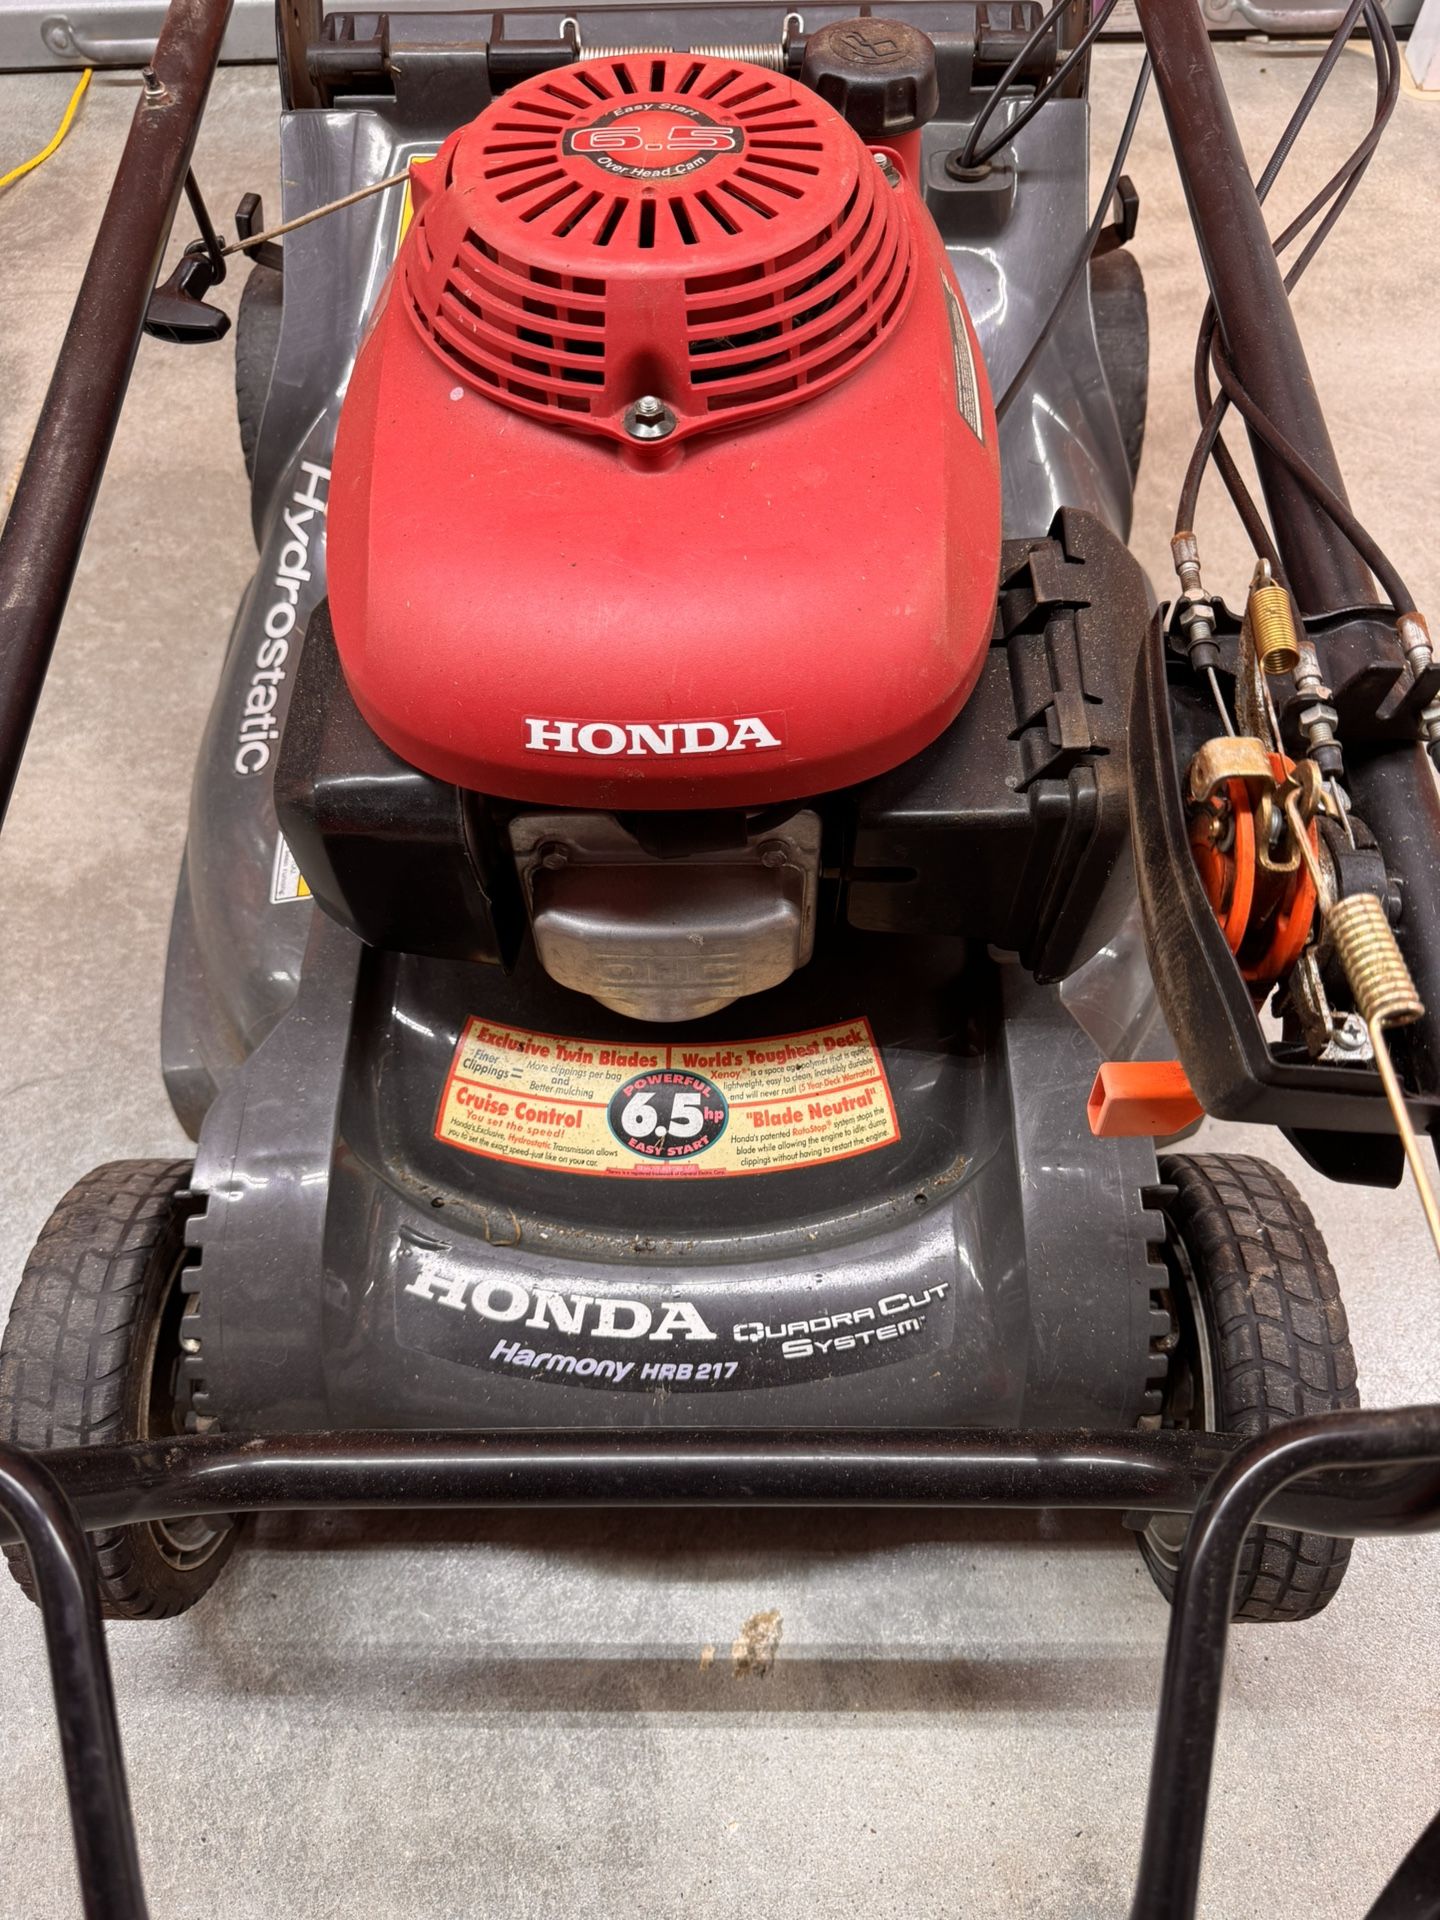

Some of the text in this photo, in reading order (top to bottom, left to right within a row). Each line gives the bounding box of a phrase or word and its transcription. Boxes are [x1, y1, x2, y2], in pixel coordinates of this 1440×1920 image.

[614, 102, 700, 117] Easy Start
[570, 126, 736, 152] 6.5
[597, 156, 707, 178] Over Head Cam
[234, 461, 331, 776] Hydrostatic
[525, 717, 782, 755] HONDA
[473, 1049, 500, 1064] Finer
[476, 1026, 658, 1068] Exclusive Twin Blades
[682, 1028, 864, 1068] World's Toughest Deck
[463, 1058, 509, 1080] Clippings
[526, 1060, 622, 1081] More clippings per bag
[551, 1076, 570, 1086] and
[764, 1065, 784, 1078] space
[786, 1062, 802, 1073] ag
[801, 1058, 828, 1072] polymer
[765, 1077, 782, 1088] easy
[783, 1075, 791, 1083] to
[848, 1057, 873, 1070] durable
[529, 1080, 594, 1099] Better mulching
[623, 1073, 712, 1098] POWERFUL
[730, 1092, 744, 1101] and
[746, 1090, 759, 1099] will
[760, 1089, 780, 1098] never
[456, 1086, 583, 1128] Cruise Control
[621, 1092, 725, 1138] 6.5 hp
[746, 1087, 877, 1128] "Blade Neutral"
[466, 1108, 565, 1139] You set the speed!
[730, 1133, 759, 1144] Honda's
[760, 1129, 791, 1143] patented
[833, 1117, 856, 1129] system
[856, 1112, 873, 1123] stops
[873, 1106, 884, 1116] the
[736, 1145, 756, 1155] blade
[757, 1143, 776, 1153] while
[777, 1138, 807, 1150] allowing
[808, 1136, 819, 1145] the
[820, 1131, 844, 1143] engine
[844, 1128, 852, 1137] to
[868, 1117, 887, 1130] dump
[448, 1128, 460, 1137] you
[479, 1137, 490, 1147] the
[544, 1151, 559, 1161] like
[558, 1156, 567, 1164] on
[569, 1158, 585, 1167] your
[508, 1133, 551, 1150] Hydrostatic
[552, 1142, 595, 1156] Transmission
[596, 1148, 619, 1157] allows
[628, 1135, 710, 1156] EASY START
[741, 1156, 771, 1168] clippings
[772, 1151, 798, 1163] without
[799, 1147, 822, 1160] having
[823, 1146, 831, 1154] to
[831, 1140, 852, 1152] restart
[853, 1136, 864, 1145] the
[404, 1257, 717, 1342] HONDA
[733, 1282, 949, 1343] QUADRA CUT
[489, 1339, 635, 1384] Harmony
